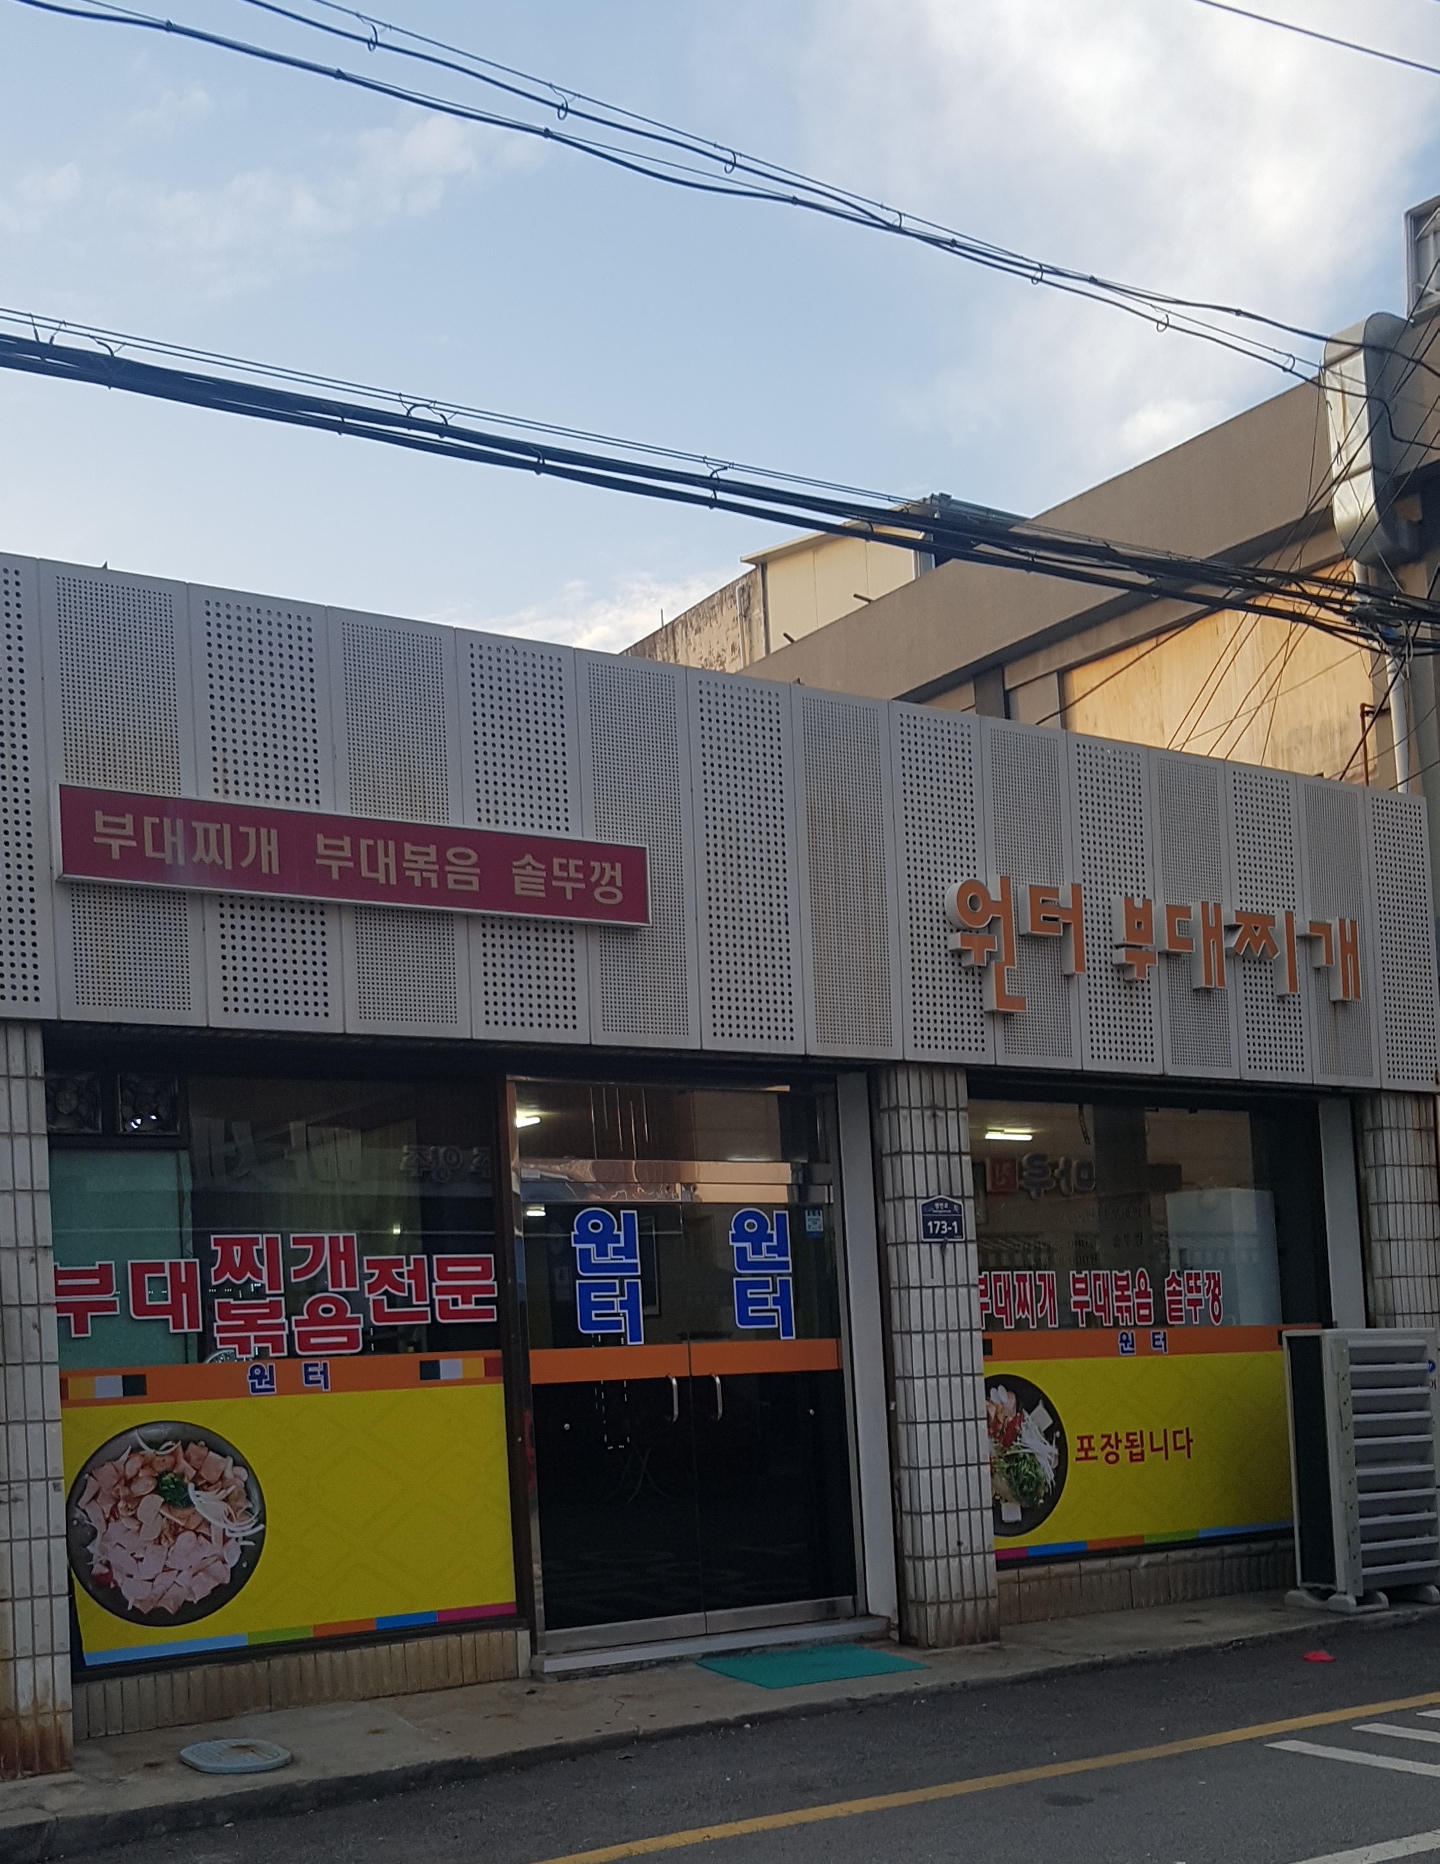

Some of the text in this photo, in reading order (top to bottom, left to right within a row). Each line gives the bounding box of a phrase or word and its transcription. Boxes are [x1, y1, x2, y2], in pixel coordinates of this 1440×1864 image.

[93, 809, 624, 905] 부대찌개 부대볶음 솥뚜껑
[951, 875, 1361, 1012] 원터 부대찌개
[729, 1207, 796, 1340] 원터
[927, 1220, 958, 1234] 173-1
[210, 1232, 361, 1294] 찌개
[363, 1253, 498, 1326] 전문
[571, 1207, 644, 1345] 원터
[1070, 1267, 1153, 1328] 부대볶음
[1165, 1269, 1224, 1326] 솥뚜껑
[212, 1293, 363, 1357] 볶음
[1075, 1426, 1194, 1465] 포장됩니다
